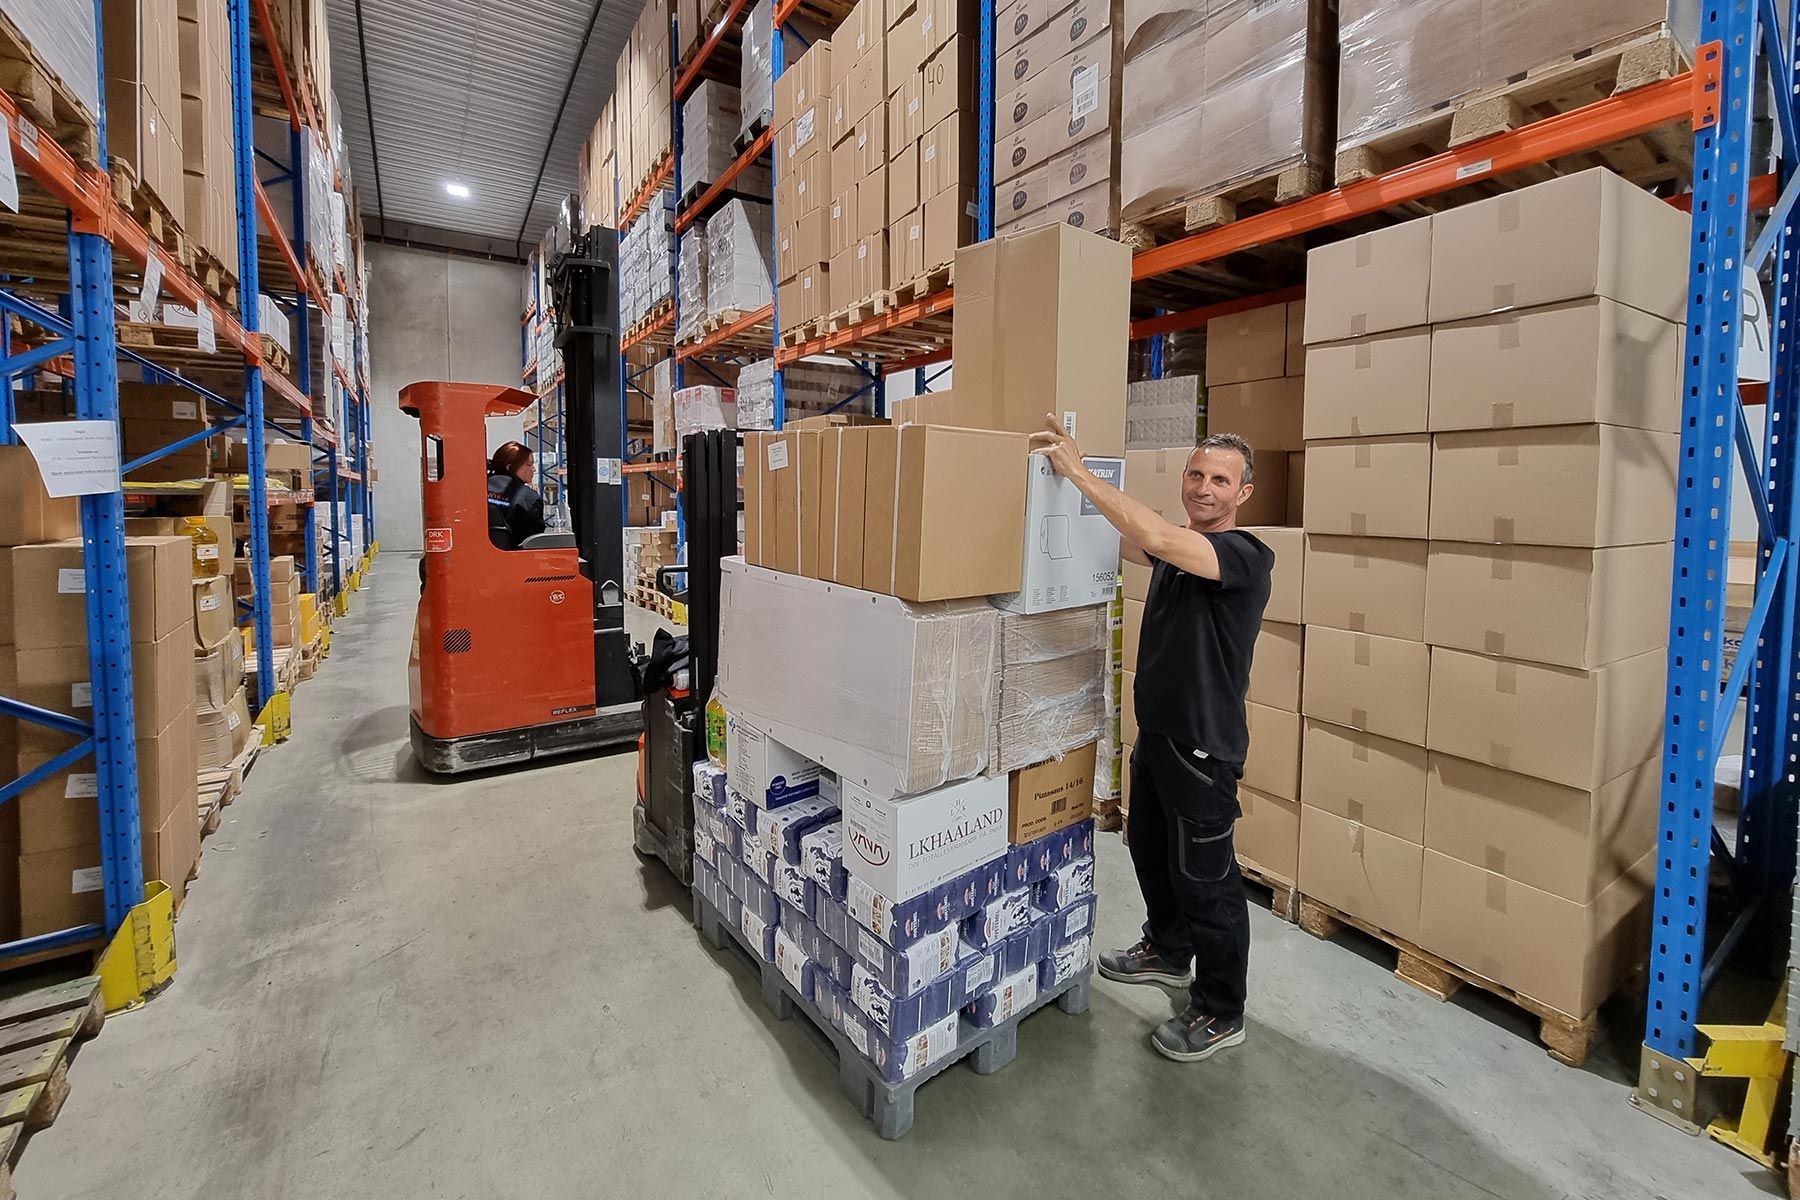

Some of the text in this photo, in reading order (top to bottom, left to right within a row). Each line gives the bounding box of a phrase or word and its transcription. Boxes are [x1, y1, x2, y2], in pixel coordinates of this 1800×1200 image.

[927, 63, 944, 96] 40
[1092, 571, 1115, 583] 156052
[552, 706, 577, 716] REFLEX
[909, 807, 1003, 861] LKHAALAND
